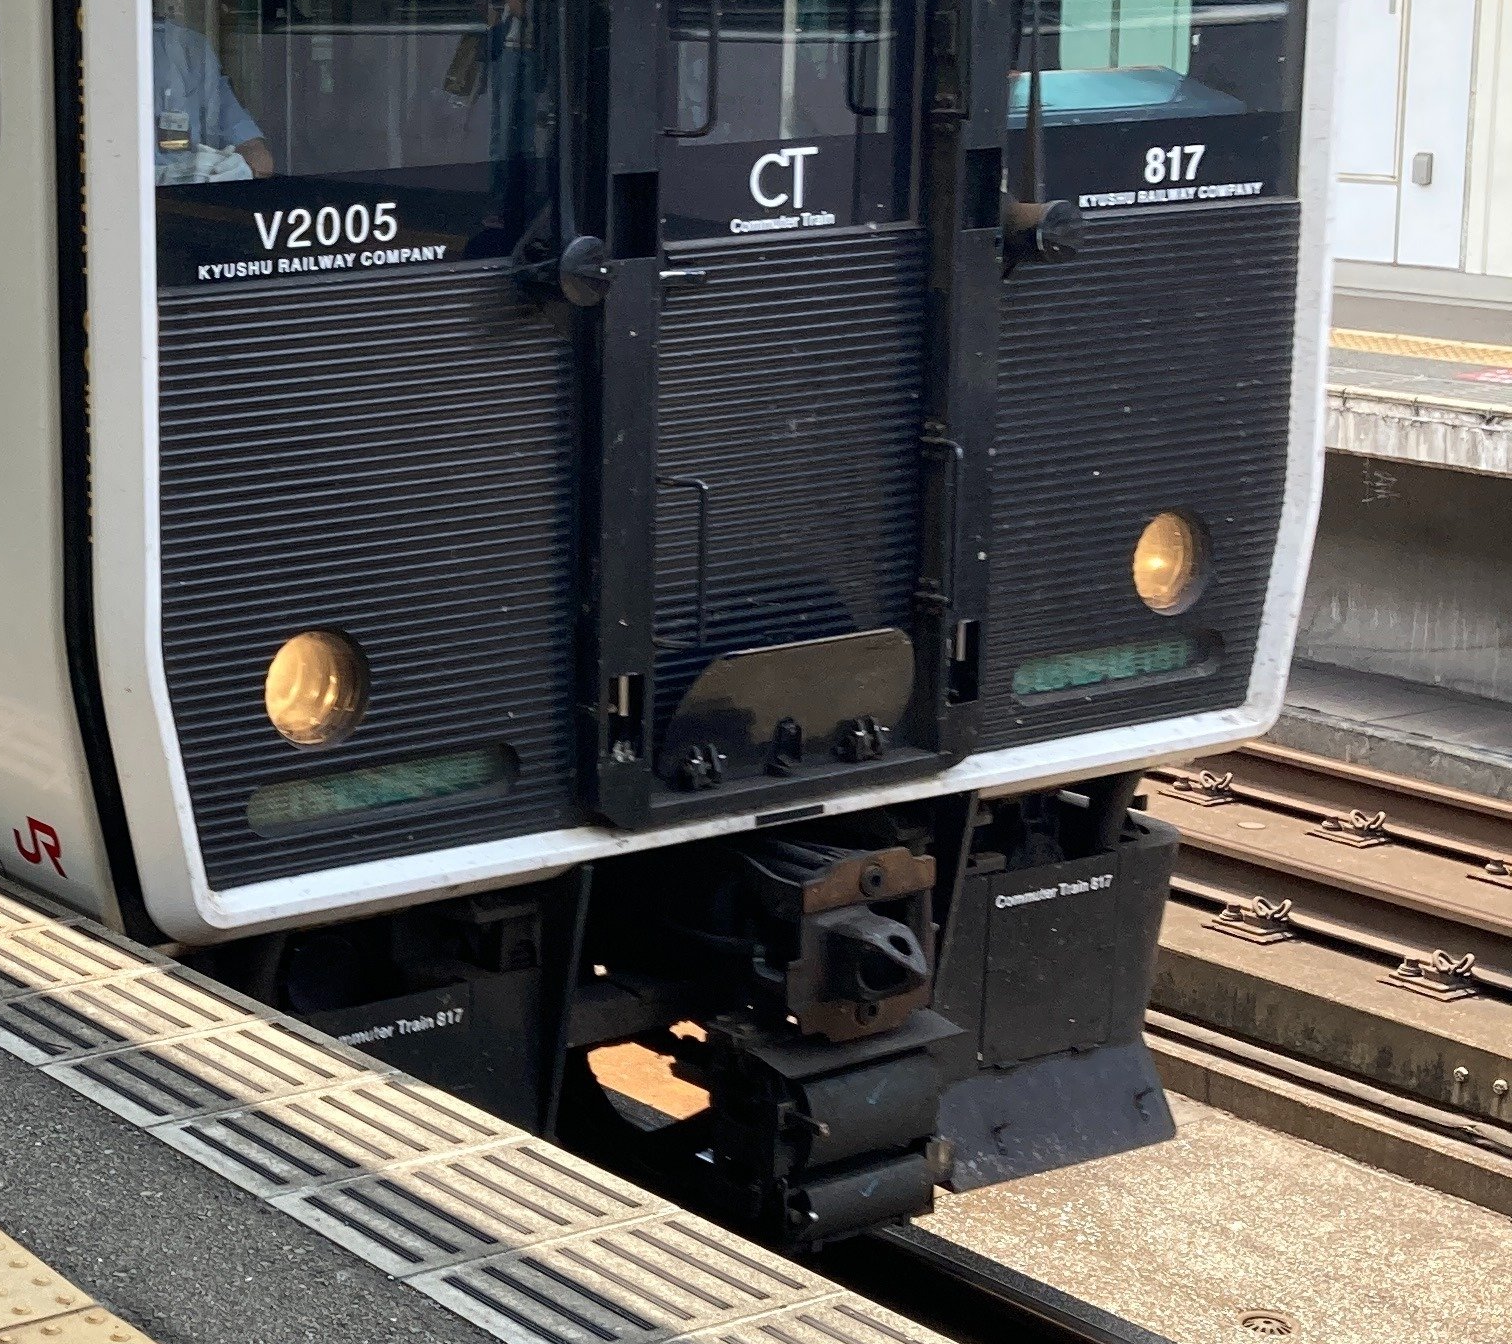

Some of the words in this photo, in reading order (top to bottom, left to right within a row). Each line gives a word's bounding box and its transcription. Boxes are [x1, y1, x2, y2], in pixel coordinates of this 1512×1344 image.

[749, 146, 819, 209] CT
[1144, 144, 1206, 184] 817
[1078, 191, 1136, 208] KYUSHU
[1137, 186, 1198, 203] RAILWAY
[1198, 182, 1263, 199] COMPANY
[253, 202, 398, 250] V2005
[730, 216, 800, 233] Commuter
[800, 210, 835, 227] Train
[198, 259, 273, 280] KYUSHU
[278, 253, 357, 273] RAILWAY
[360, 245, 447, 266] COMPANY
[12, 816, 68, 879] JR
[995, 887, 1058, 909] Commuter
[1058, 879, 1089, 896] Train
[1090, 874, 1113, 891] 817
[338, 1025, 394, 1046] mmuter
[395, 1015, 435, 1035] Train
[436, 1008, 464, 1027] 817
